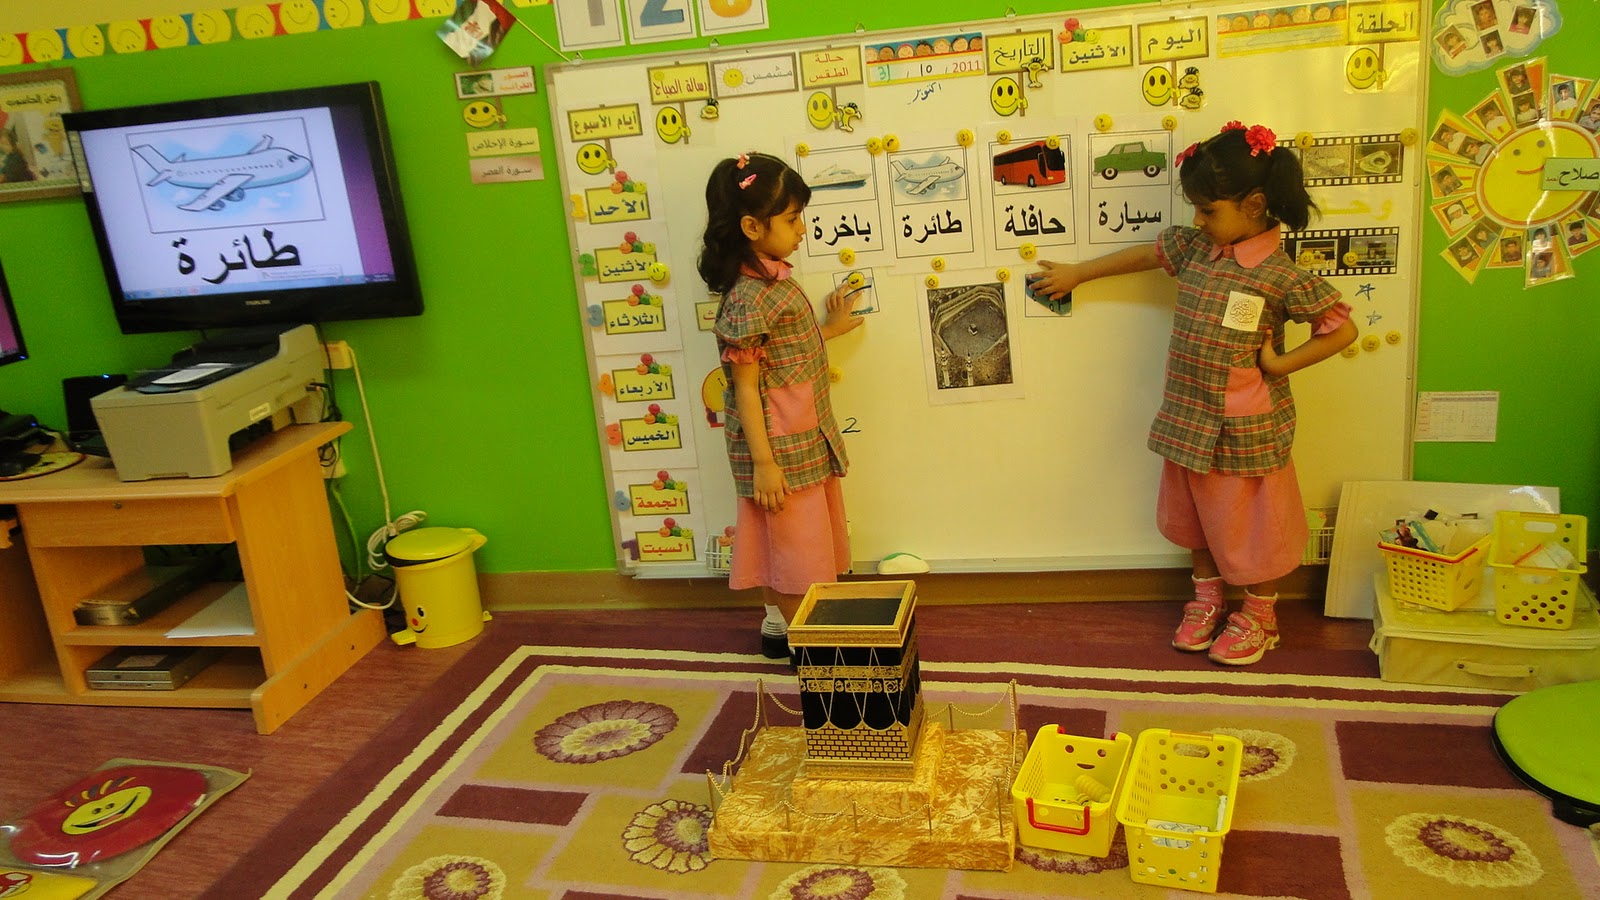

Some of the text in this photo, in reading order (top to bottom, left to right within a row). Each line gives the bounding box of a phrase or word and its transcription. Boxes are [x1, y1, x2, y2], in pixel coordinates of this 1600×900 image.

[1356, 11, 1414, 34] الحلقة
[993, 36, 1046, 65] التاريخ
[1147, 28, 1202, 54] اليوم
[920, 64, 933, 77] 10
[952, 60, 981, 74] 2011
[653, 77, 708, 98] رسالة الصباح
[594, 198, 646, 217] الأحد
[1098, 201, 1162, 232] سيارة
[814, 214, 872, 246] باخرة
[902, 209, 962, 244] طائرة
[1004, 203, 1066, 237] حافلة
[172, 227, 302, 284] طائرة
[609, 313, 659, 329] الثلاثاء
[620, 381, 669, 397] الأربعاء
[841, 417, 862, 434] 2
[628, 430, 675, 445] الخميس
[637, 496, 684, 509] الجمعة
[642, 543, 690, 554] السبت
